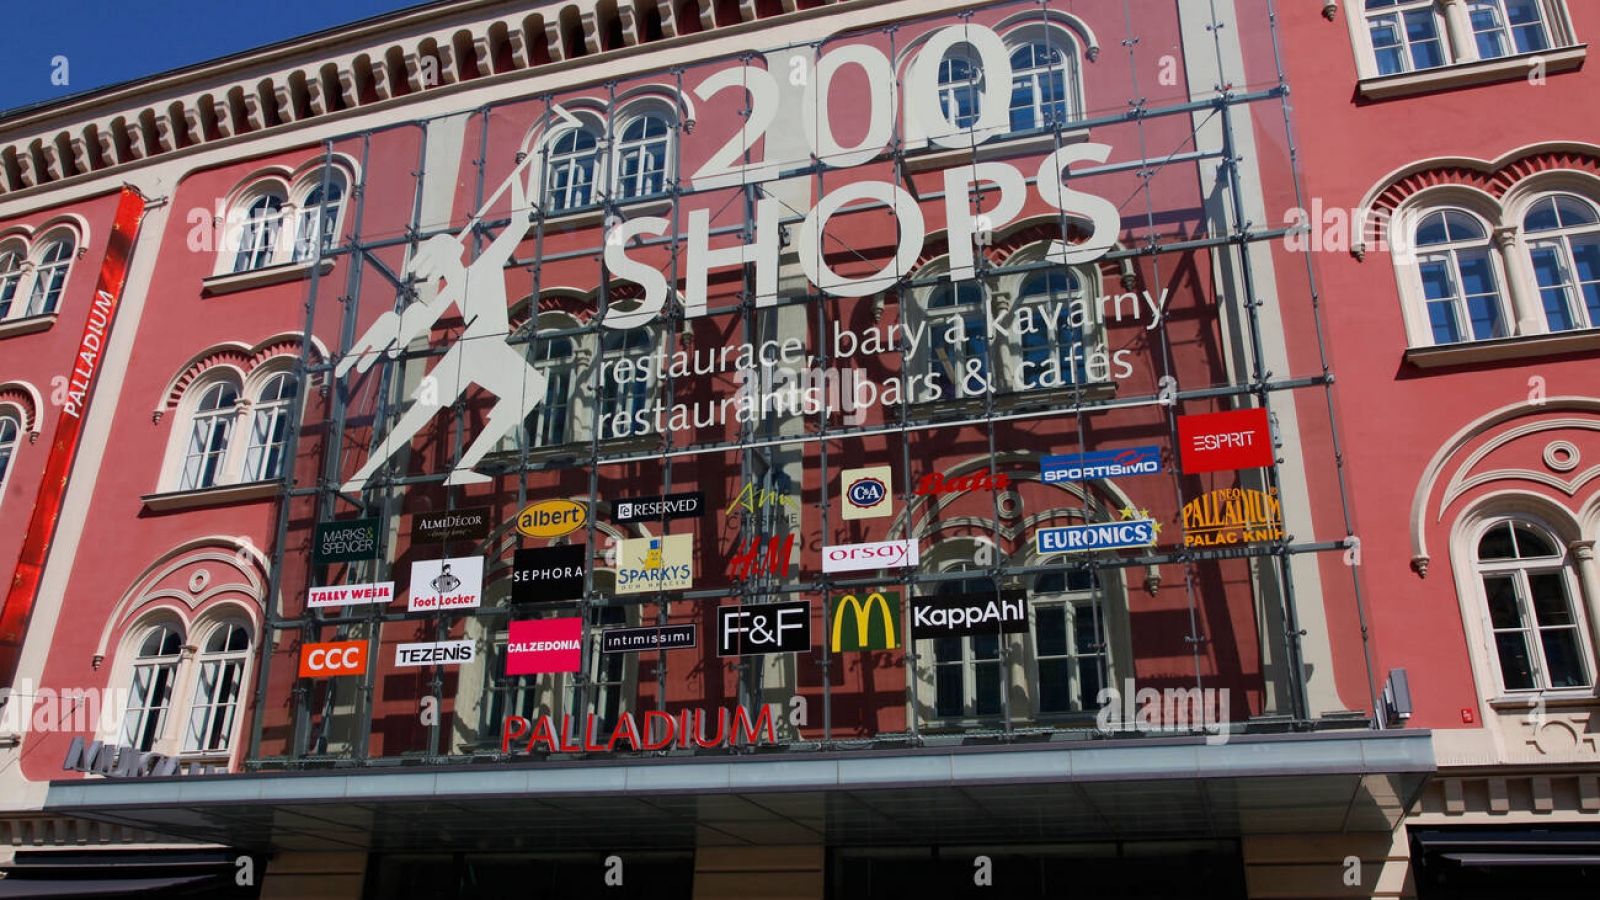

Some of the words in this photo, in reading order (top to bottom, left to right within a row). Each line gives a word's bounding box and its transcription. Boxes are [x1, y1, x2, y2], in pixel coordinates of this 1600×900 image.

[692, 24, 1012, 190] 200
[602, 142, 1121, 330] SHOPS
[600, 338, 814, 386] restaurace,
[834, 320, 926, 361] bary
[944, 314, 970, 344] a
[985, 288, 1168, 341] kavárny
[63, 288, 114, 418] PALLADIUM
[853, 368, 942, 409] bars
[962, 358, 996, 396] &
[1015, 341, 1133, 389] cafés
[1193, 431, 1256, 451] ESPRIT
[853, 485, 881, 502] C&A
[522, 506, 580, 529] albert
[633, 499, 699, 517] RESERVED
[1182, 489, 1282, 528] PALLADIUM
[322, 539, 374, 555] SPENCER
[1043, 524, 1148, 549] EURONICS
[1185, 530, 1238, 547] PALÁC
[829, 544, 911, 566] orsay
[514, 566, 584, 582] SEPHORA
[617, 563, 691, 585] SPARKYS
[311, 589, 348, 603] TALLY
[413, 596, 436, 607] Foot
[439, 594, 475, 605] Locker
[914, 599, 1025, 630] KappAhl
[608, 632, 690, 647] intimissimi
[724, 607, 804, 650] F&F
[507, 639, 581, 653] CALZEDONIA
[308, 647, 359, 671] CCC
[501, 703, 778, 753] PALLADIUM
